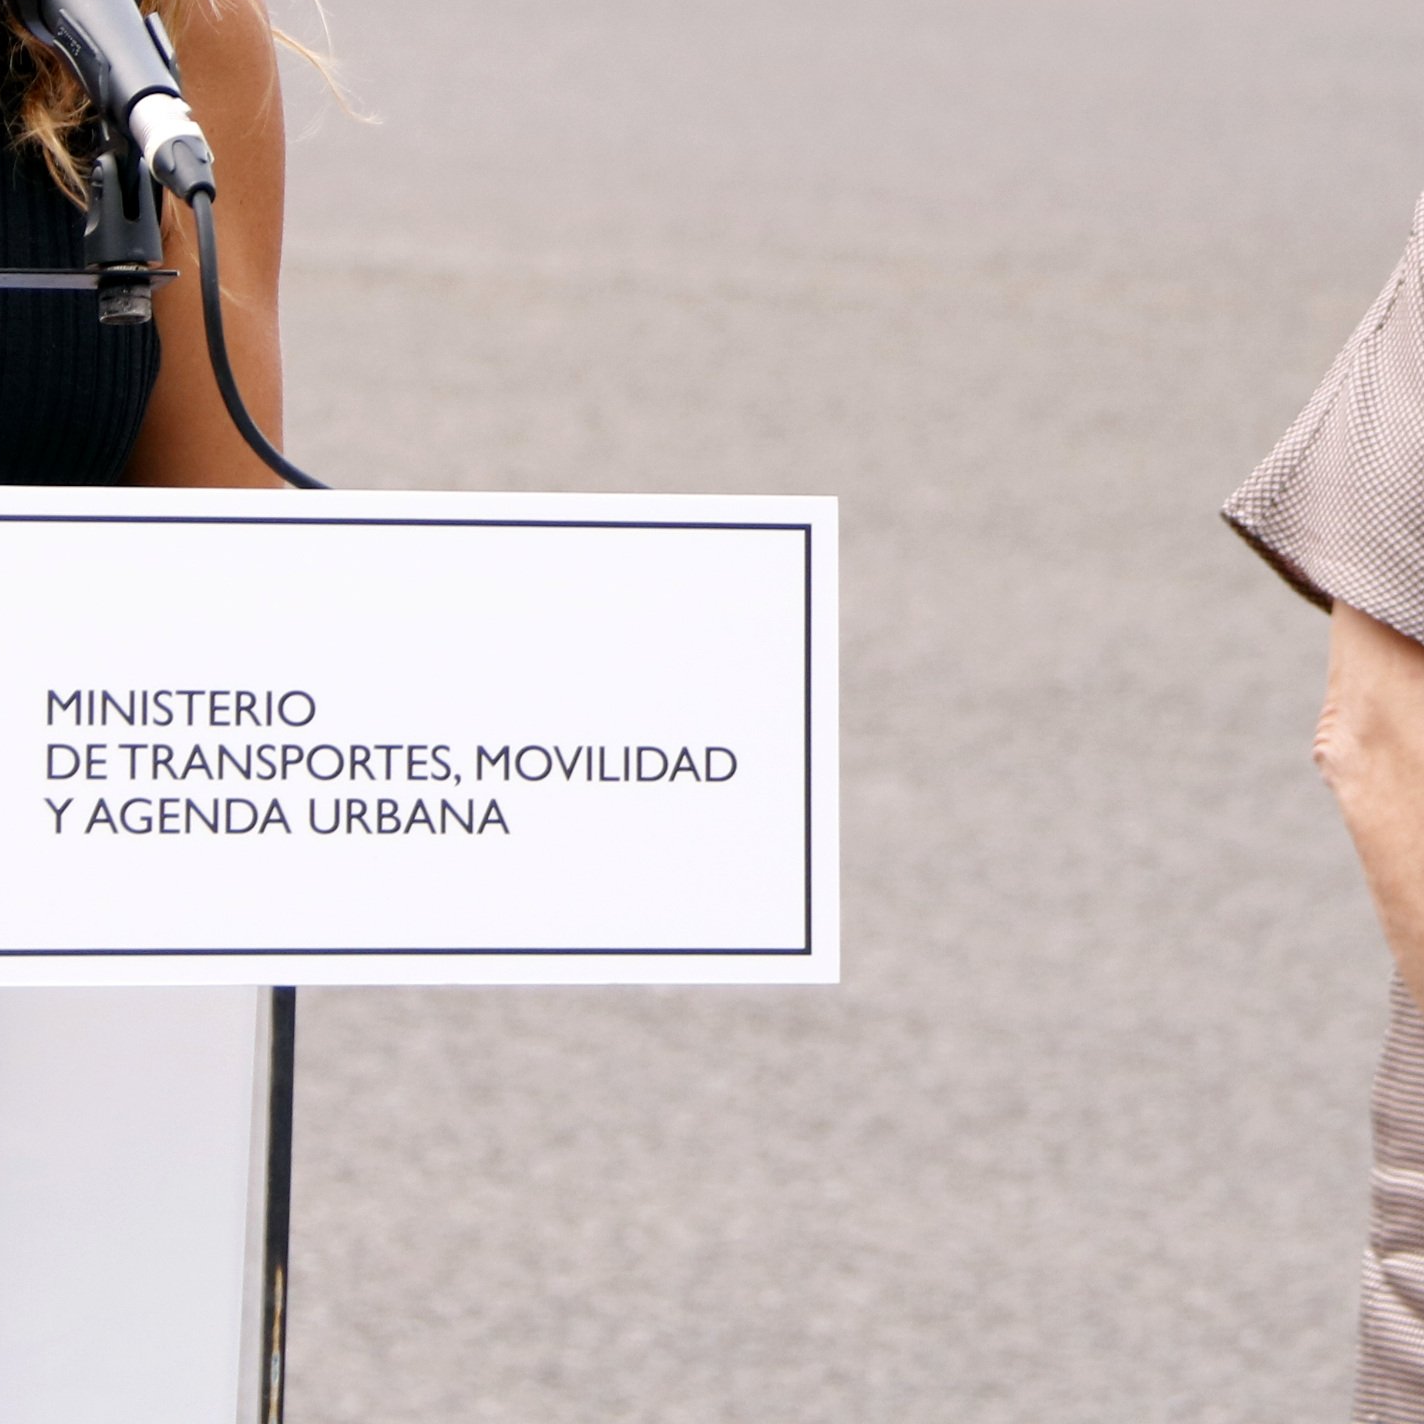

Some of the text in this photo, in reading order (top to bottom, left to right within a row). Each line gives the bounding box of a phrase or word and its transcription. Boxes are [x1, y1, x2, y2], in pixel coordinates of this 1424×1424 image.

[47, 689, 316, 727] MINISTERIO
[46, 743, 738, 786] DE TRANSPORTES, MOVILIDAD
[44, 797, 510, 835] Y AGENDA URBANA
